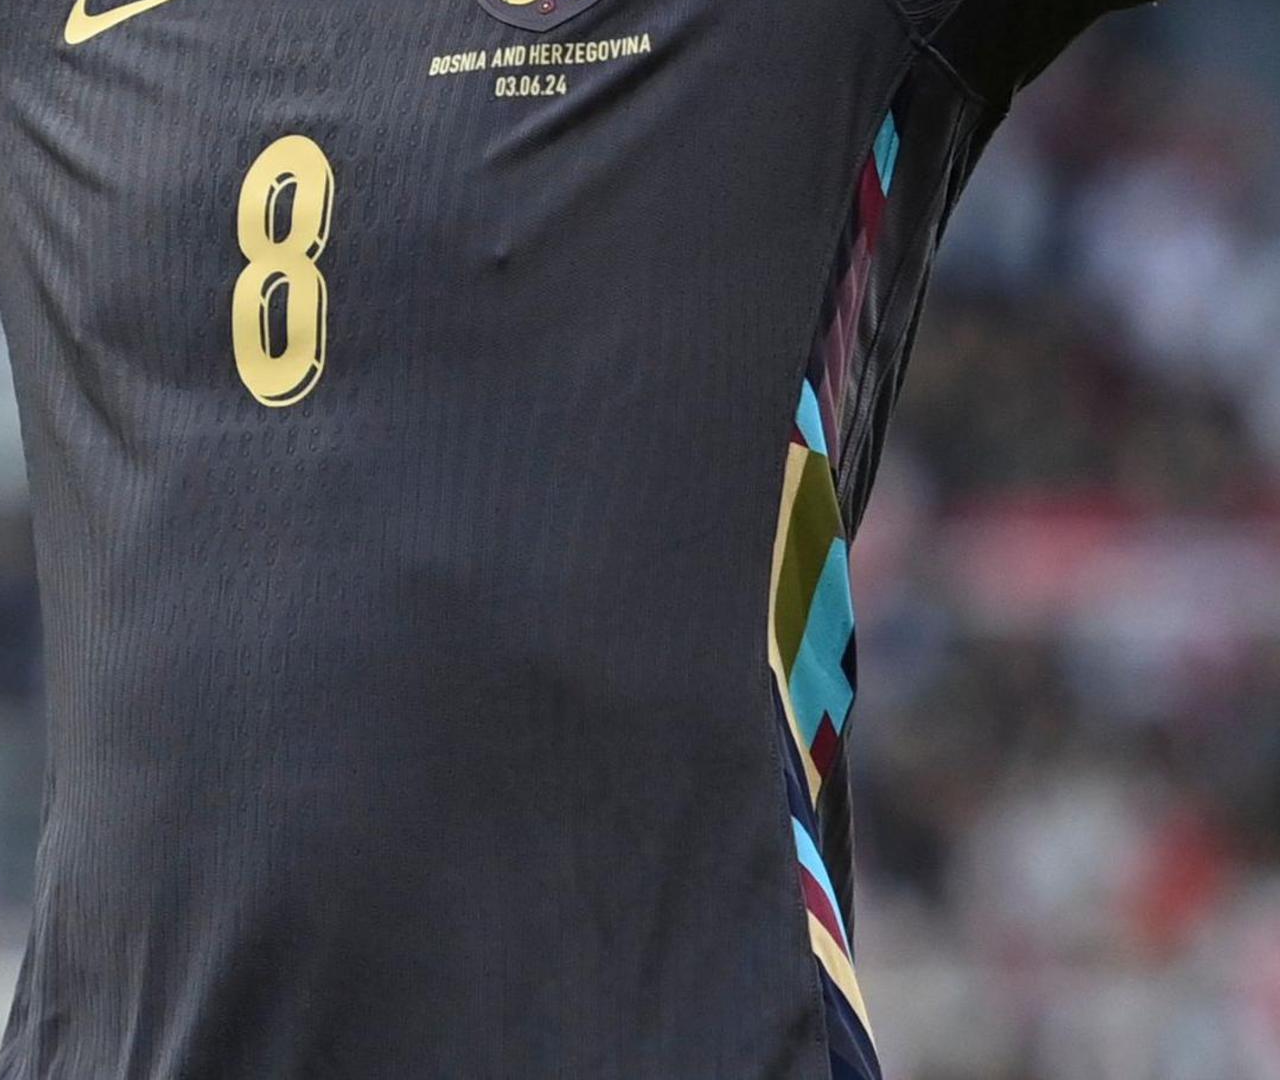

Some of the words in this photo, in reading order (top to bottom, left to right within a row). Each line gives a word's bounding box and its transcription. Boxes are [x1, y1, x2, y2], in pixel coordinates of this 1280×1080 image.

[429, 50, 486, 76] BOSNIA
[491, 46, 526, 68] AND
[529, 33, 651, 66] HERZEGOVINA
[495, 74, 567, 97] 03.06.24
[231, 134, 335, 408] 8
